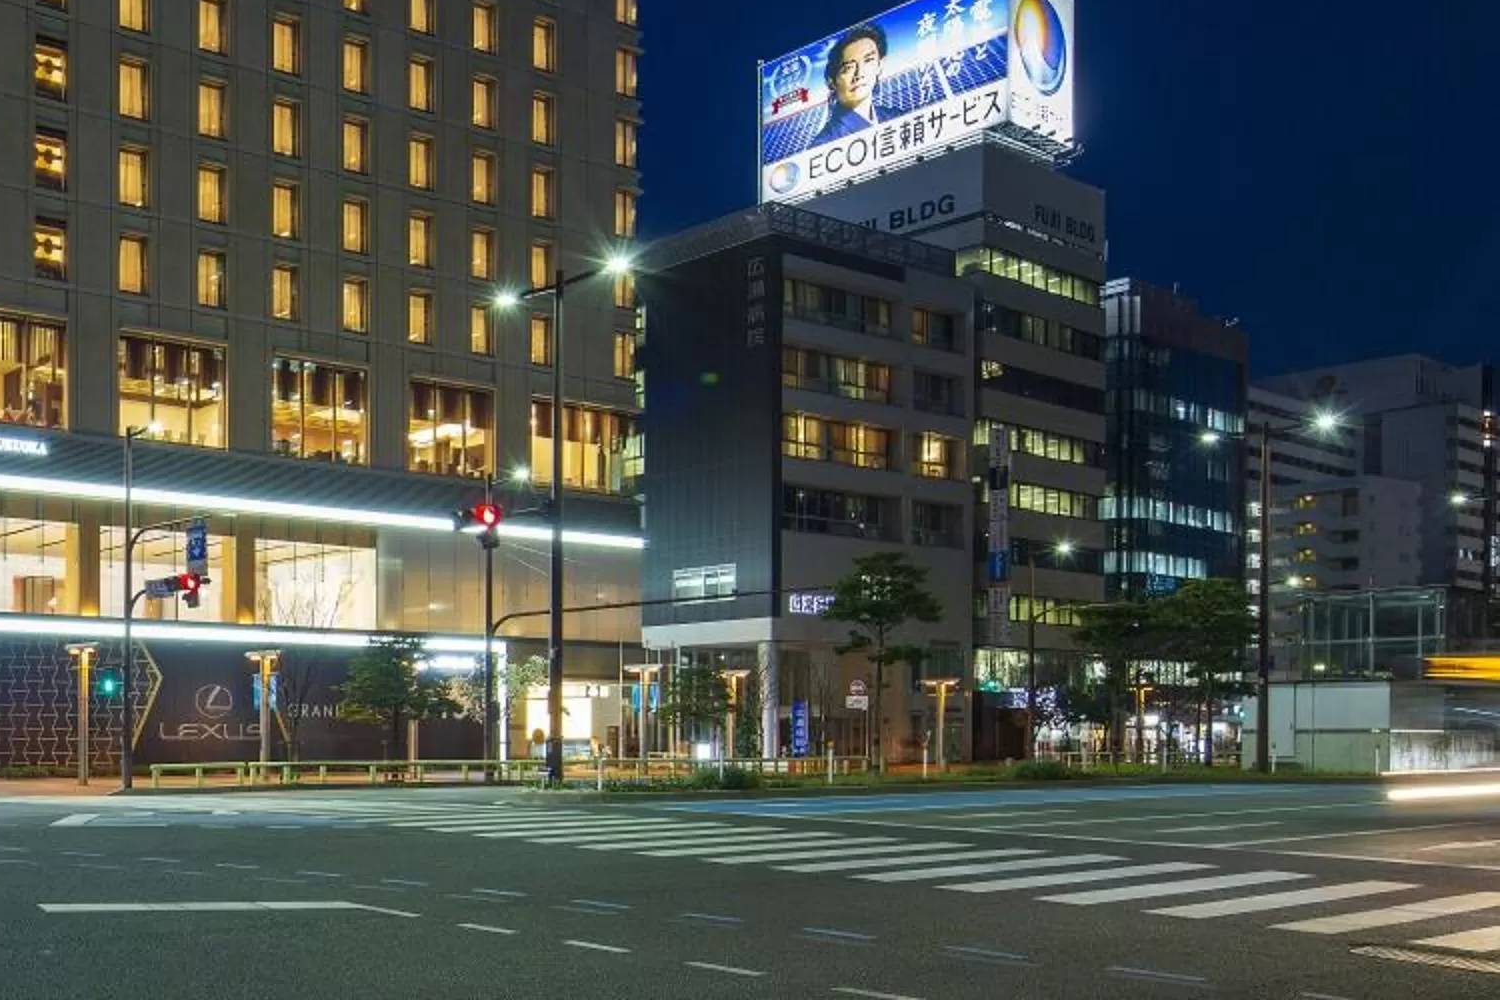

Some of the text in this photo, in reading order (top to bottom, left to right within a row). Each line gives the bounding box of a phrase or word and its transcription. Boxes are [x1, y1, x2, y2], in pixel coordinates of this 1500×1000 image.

[808, 90, 1002, 181] ECO信頼サービス
[889, 193, 956, 230] BLDG
[1065, 215, 1096, 243] BLDG
[160, 722, 262, 740] LEXUS
